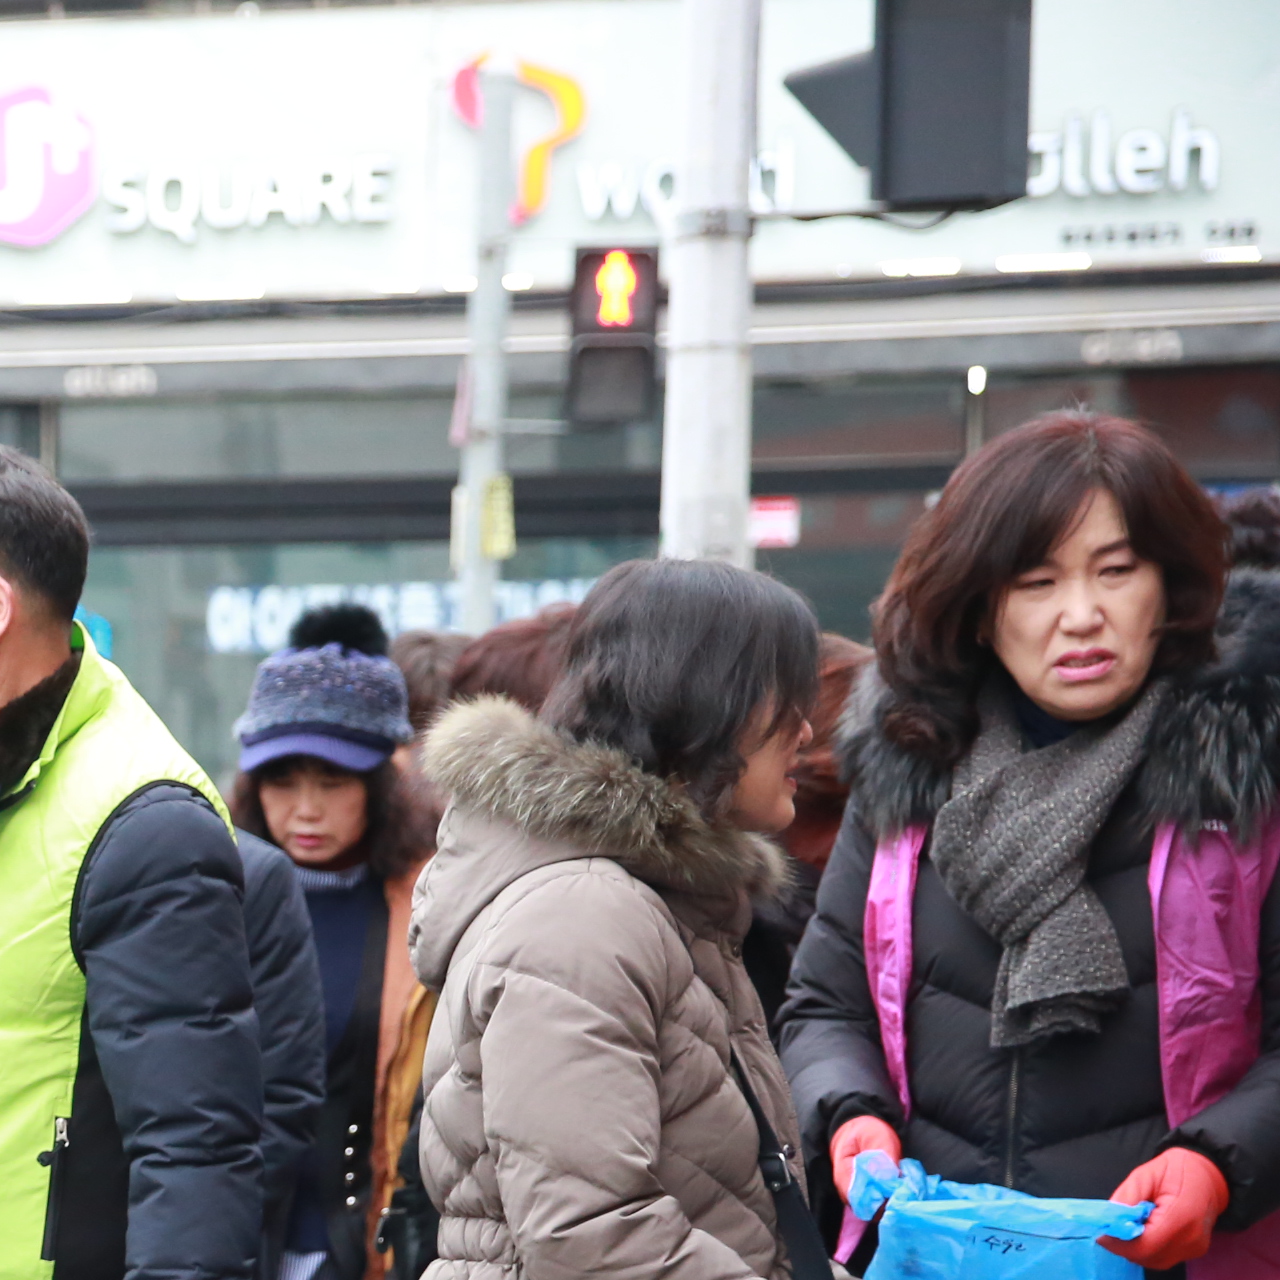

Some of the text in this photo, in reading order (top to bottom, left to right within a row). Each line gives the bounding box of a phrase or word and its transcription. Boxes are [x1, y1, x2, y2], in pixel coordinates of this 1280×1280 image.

[575, 140, 795, 222] wod
[1027, 104, 1220, 197] olleh
[102, 155, 396, 243] SQUARE
